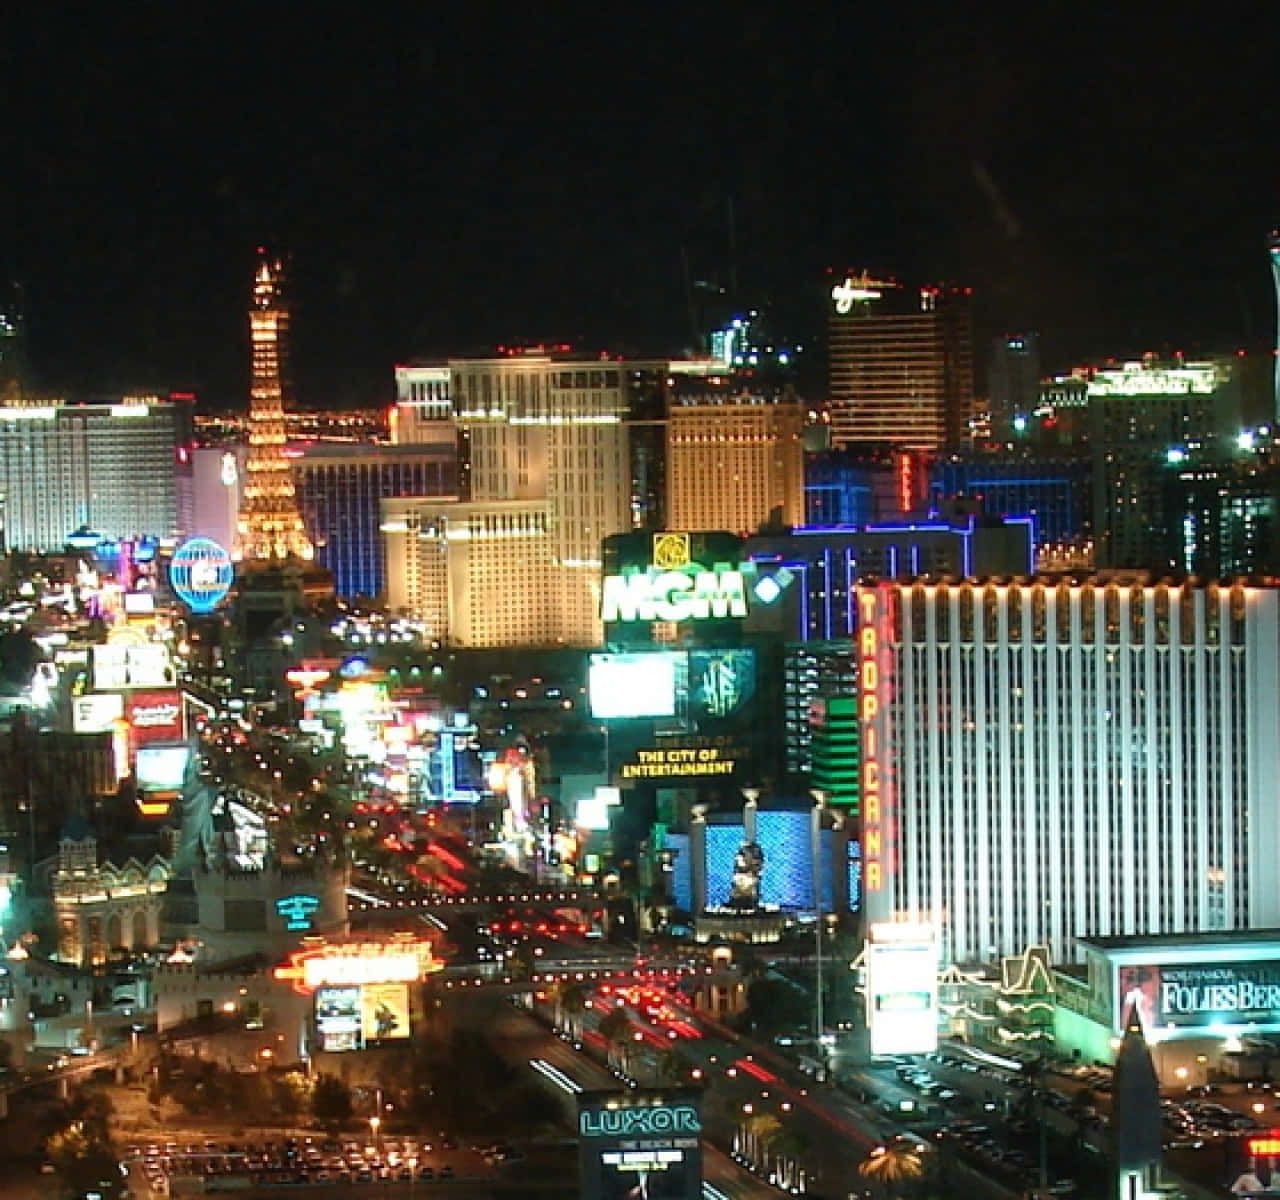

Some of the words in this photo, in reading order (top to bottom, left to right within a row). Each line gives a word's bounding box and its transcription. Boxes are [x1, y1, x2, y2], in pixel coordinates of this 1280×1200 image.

[602, 571, 747, 621] MGM
[638, 751, 665, 764] THE
[667, 750, 696, 763] CITY
[699, 748, 719, 762] OF
[860, 591, 882, 892] TROPICANA
[623, 761, 735, 778] ENTERTAINMENT
[1161, 982, 1237, 1014] FOLIES
[580, 1106, 702, 1136] LUXOR
